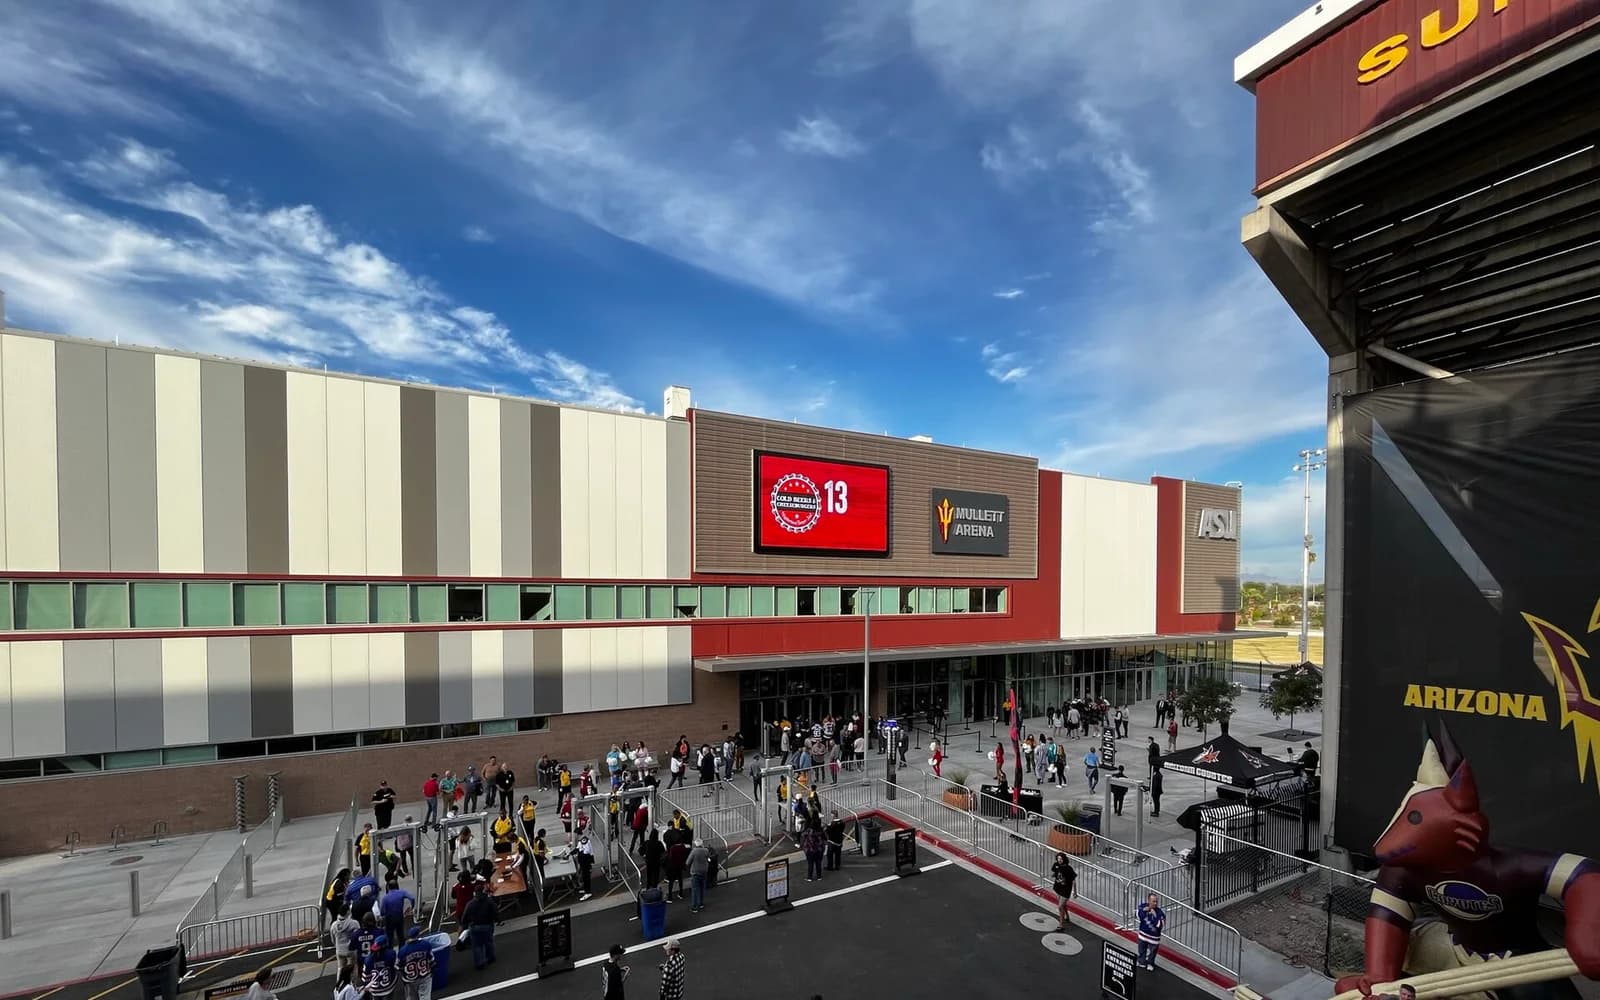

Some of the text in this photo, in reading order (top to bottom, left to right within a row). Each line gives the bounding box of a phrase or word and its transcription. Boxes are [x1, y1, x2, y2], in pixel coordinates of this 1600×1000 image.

[1357, 0, 1509, 84] SU
[824, 480, 848, 514] 13
[956, 507, 1005, 522] MULLETT
[1198, 508, 1237, 539] ASU
[955, 524, 994, 537] ARENA
[1403, 684, 1548, 722] ARIZONA
[1106, 947, 1134, 965] ADDITIONAL
[1107, 954, 1132, 970] ENTRANCE
[404, 959, 431, 980] 99
[1113, 970, 1125, 980] SIDE
